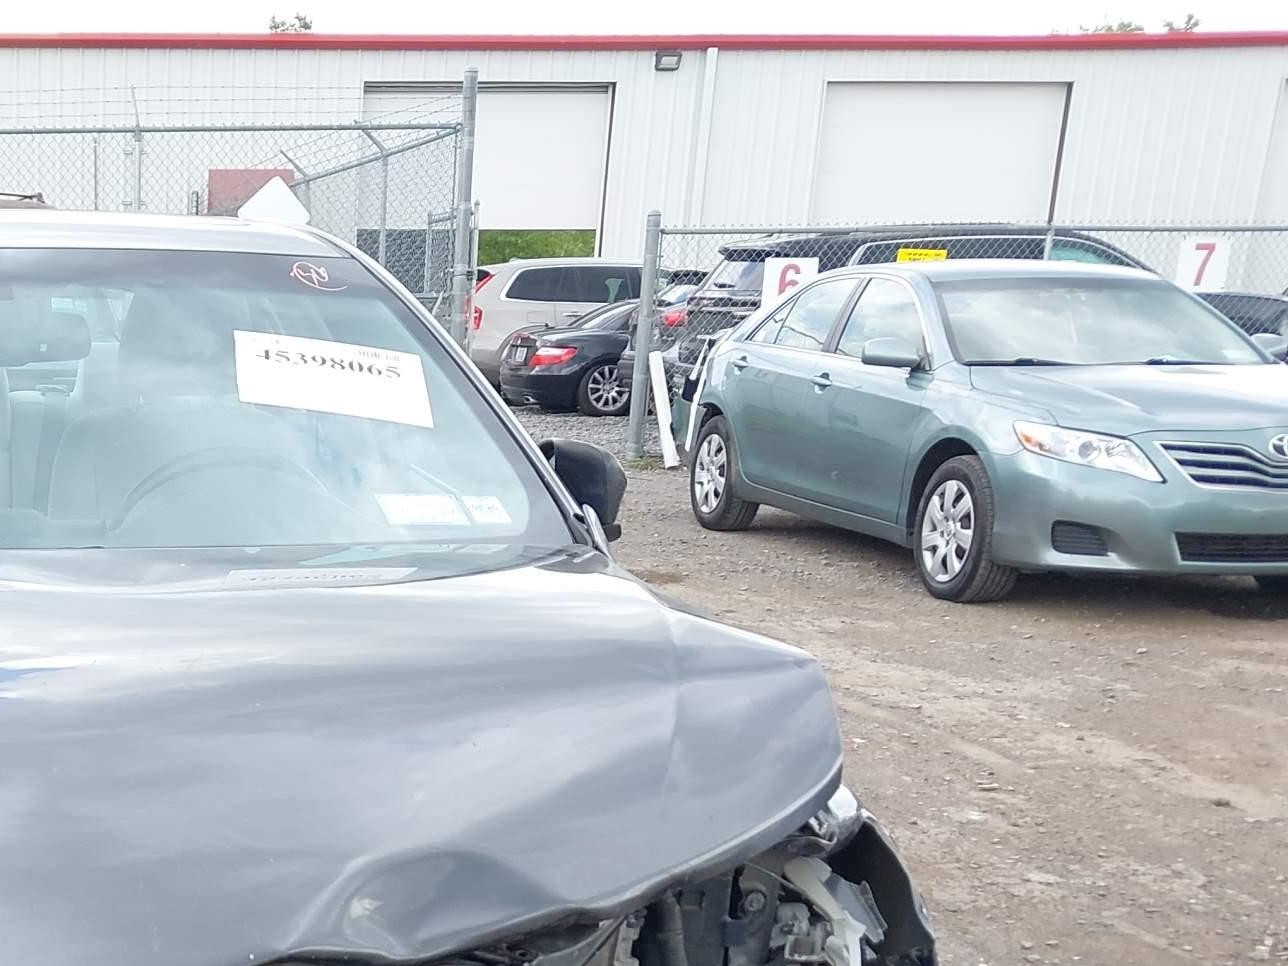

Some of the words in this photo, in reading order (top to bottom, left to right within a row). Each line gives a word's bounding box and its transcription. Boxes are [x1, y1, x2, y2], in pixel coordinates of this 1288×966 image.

[777, 263, 801, 297] 6
[1193, 242, 1217, 287] 7
[255, 349, 402, 380] 45398065
